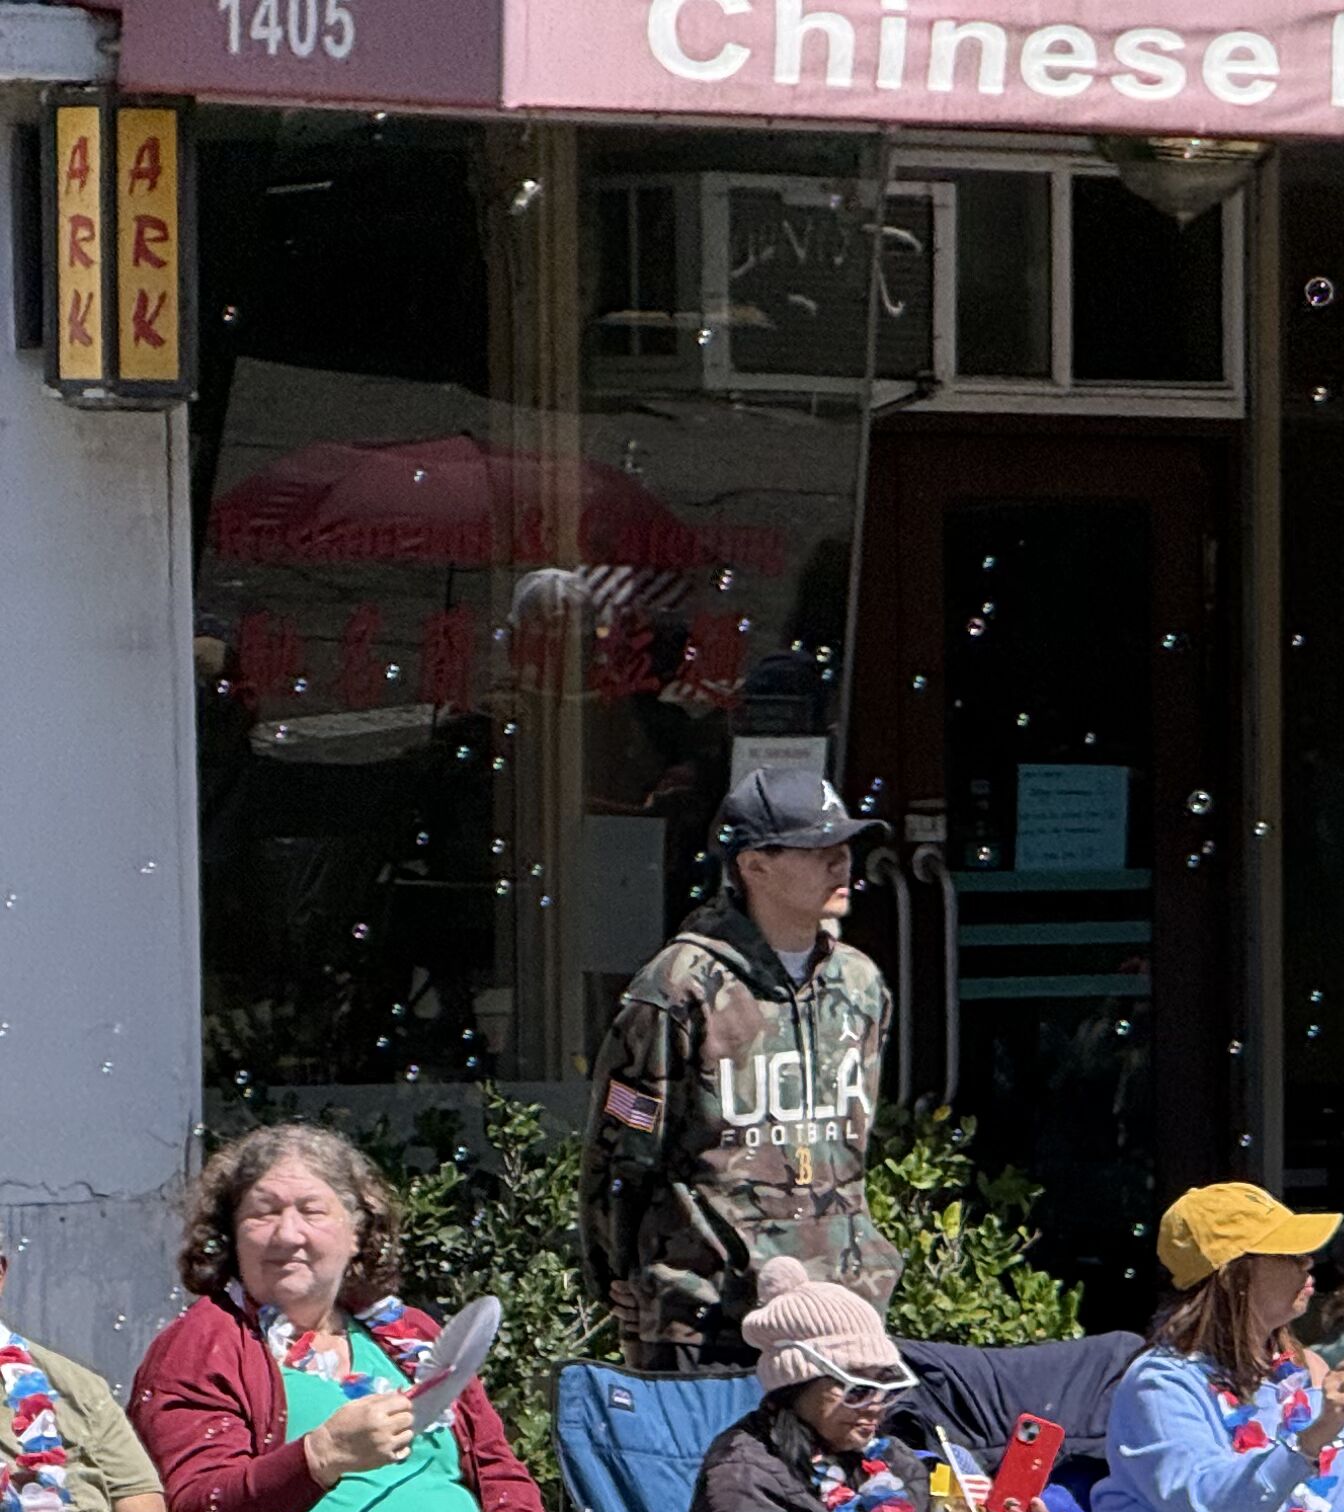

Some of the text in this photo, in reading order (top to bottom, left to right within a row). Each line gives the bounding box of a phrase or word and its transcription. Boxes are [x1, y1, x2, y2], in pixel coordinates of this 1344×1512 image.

[218, 0, 355, 60] 1405
[646, 0, 1281, 107] Chinese
[719, 1047, 873, 1127] UCLA
[720, 1119, 869, 1149] FOOTBAL
